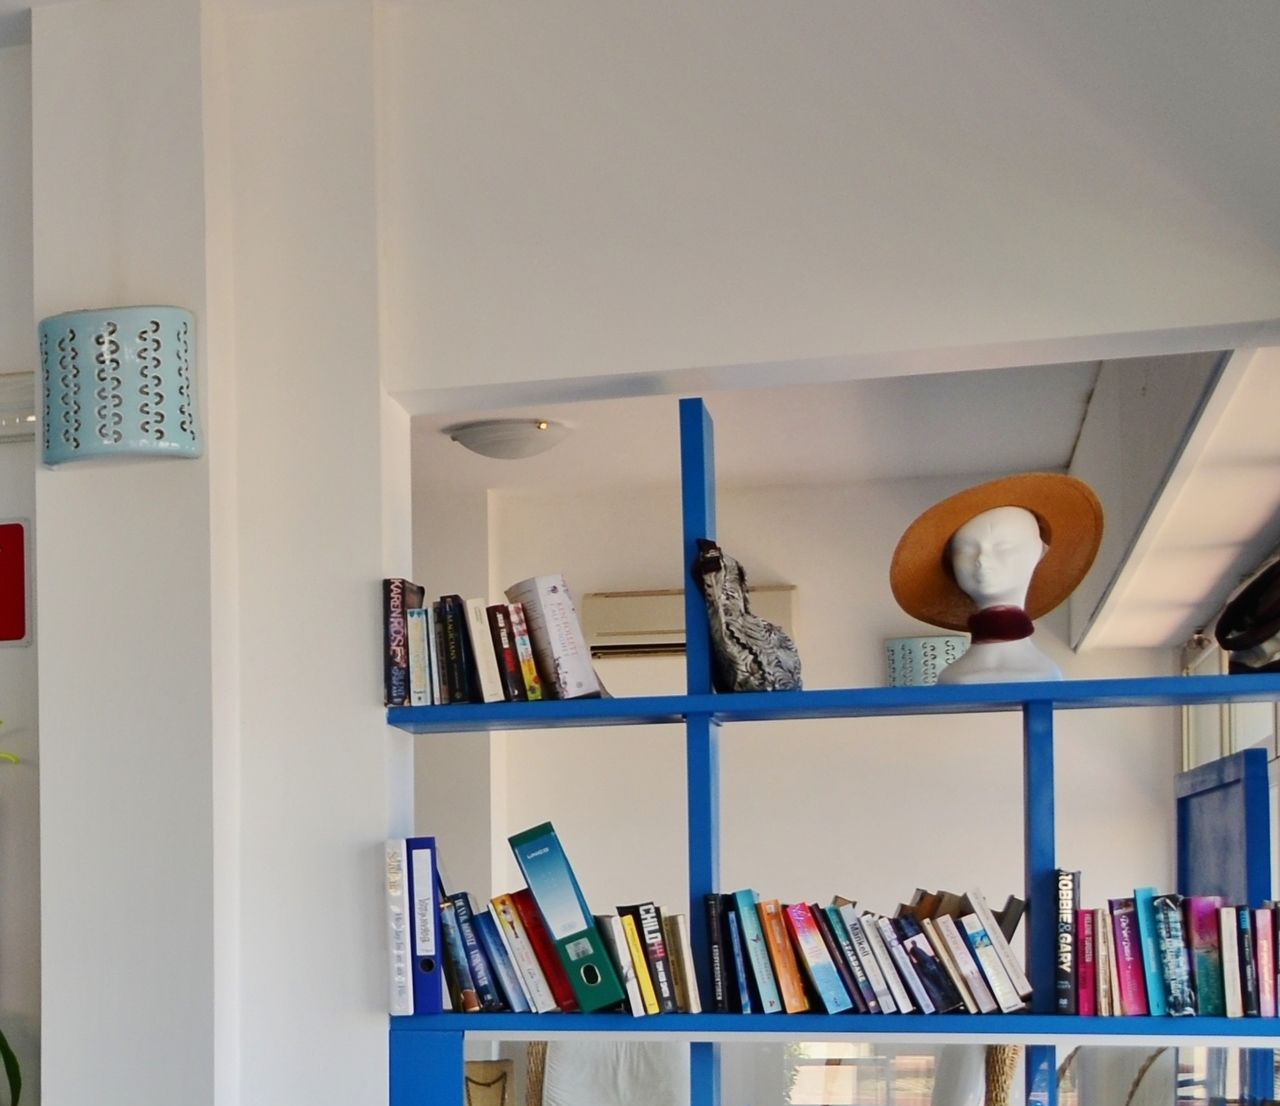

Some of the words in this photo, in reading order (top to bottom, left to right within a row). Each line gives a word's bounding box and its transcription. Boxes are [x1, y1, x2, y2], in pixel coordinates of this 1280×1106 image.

[390, 577, 403, 616] KAREN
[389, 616, 405, 656] ROSE
[638, 903, 661, 944] CHILD
[1058, 933, 1072, 973] GARY
